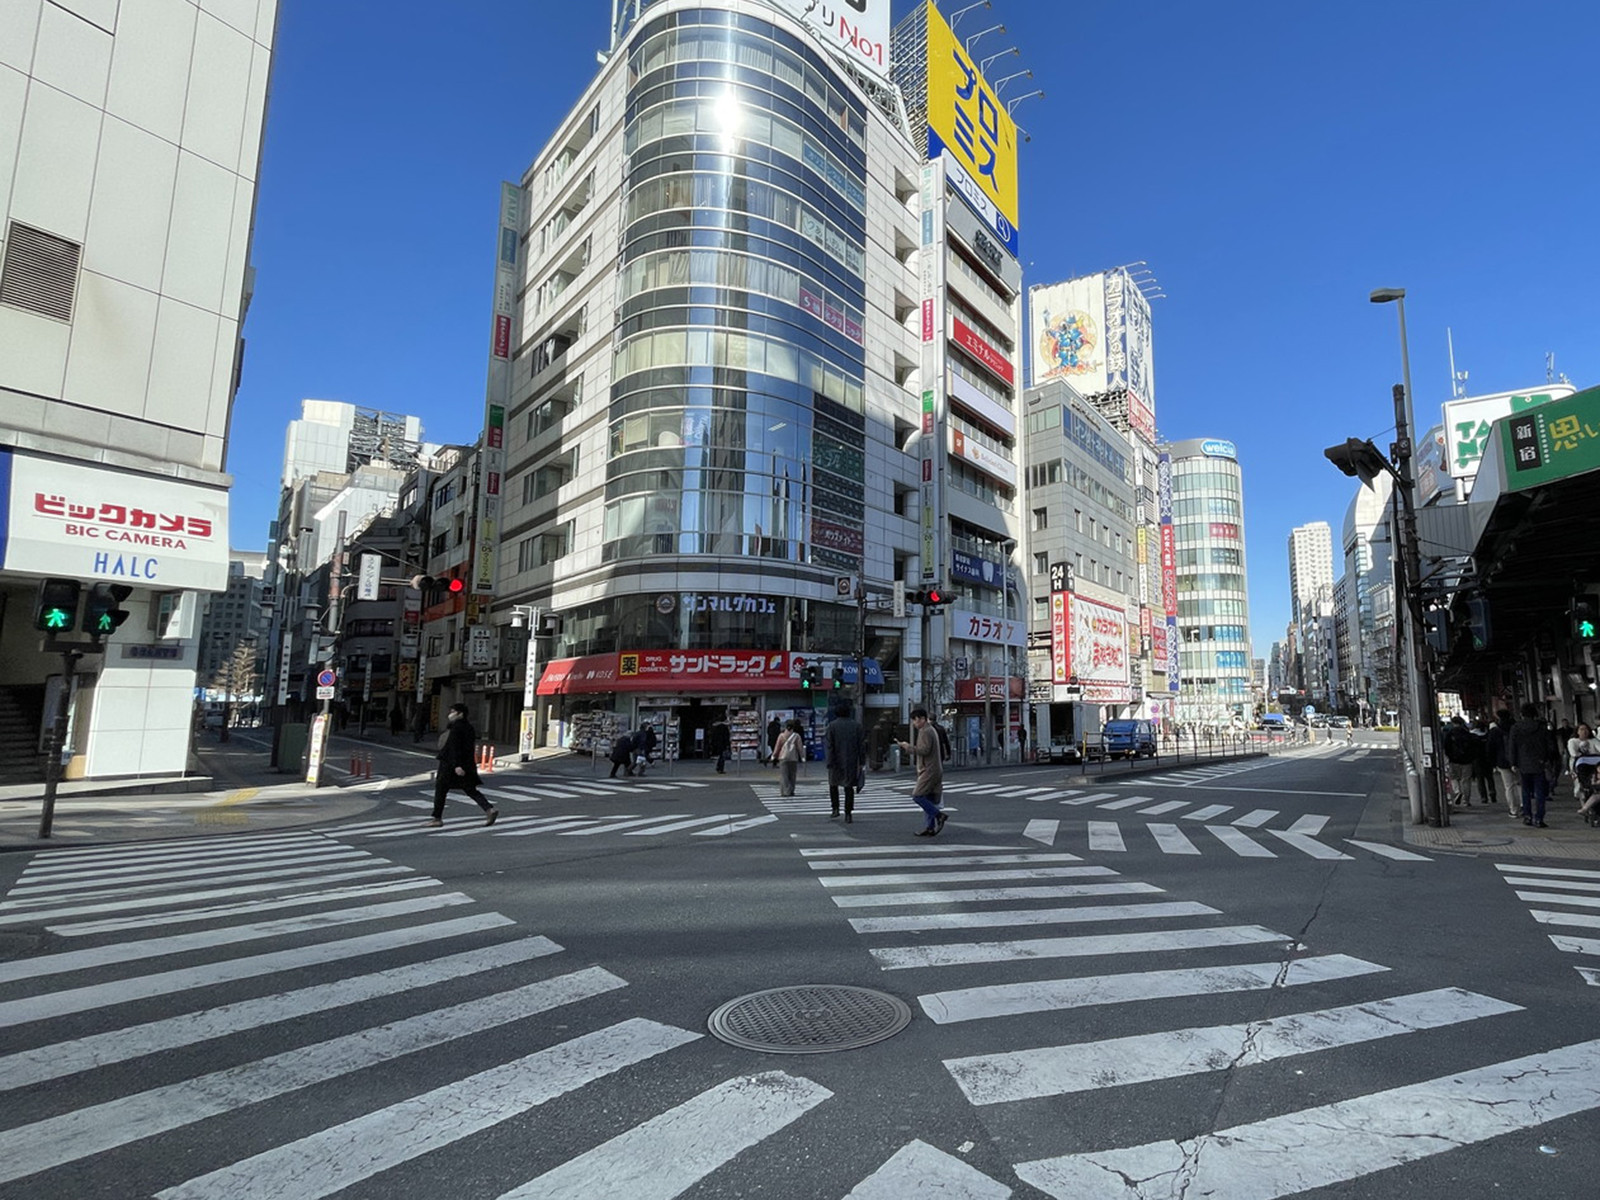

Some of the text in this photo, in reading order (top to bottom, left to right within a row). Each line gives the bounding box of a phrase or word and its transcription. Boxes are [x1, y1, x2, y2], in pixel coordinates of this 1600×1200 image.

[956, 167, 990, 216] プロミス
[1106, 273, 1127, 390] カラオケの鉄人
[1516, 424, 1537, 462] 新宿
[35, 493, 212, 538] ビックカメラ
[65, 524, 187, 550] BIC CAMERA
[94, 552, 158, 579] HALC
[1051, 566, 1064, 580] 24
[1054, 580, 1062, 590] H
[969, 616, 1014, 641] カラオケ
[1055, 613, 1063, 663] カラオケ
[622, 656, 637, 674] 薬
[669, 655, 765, 673] サンドラッグ
